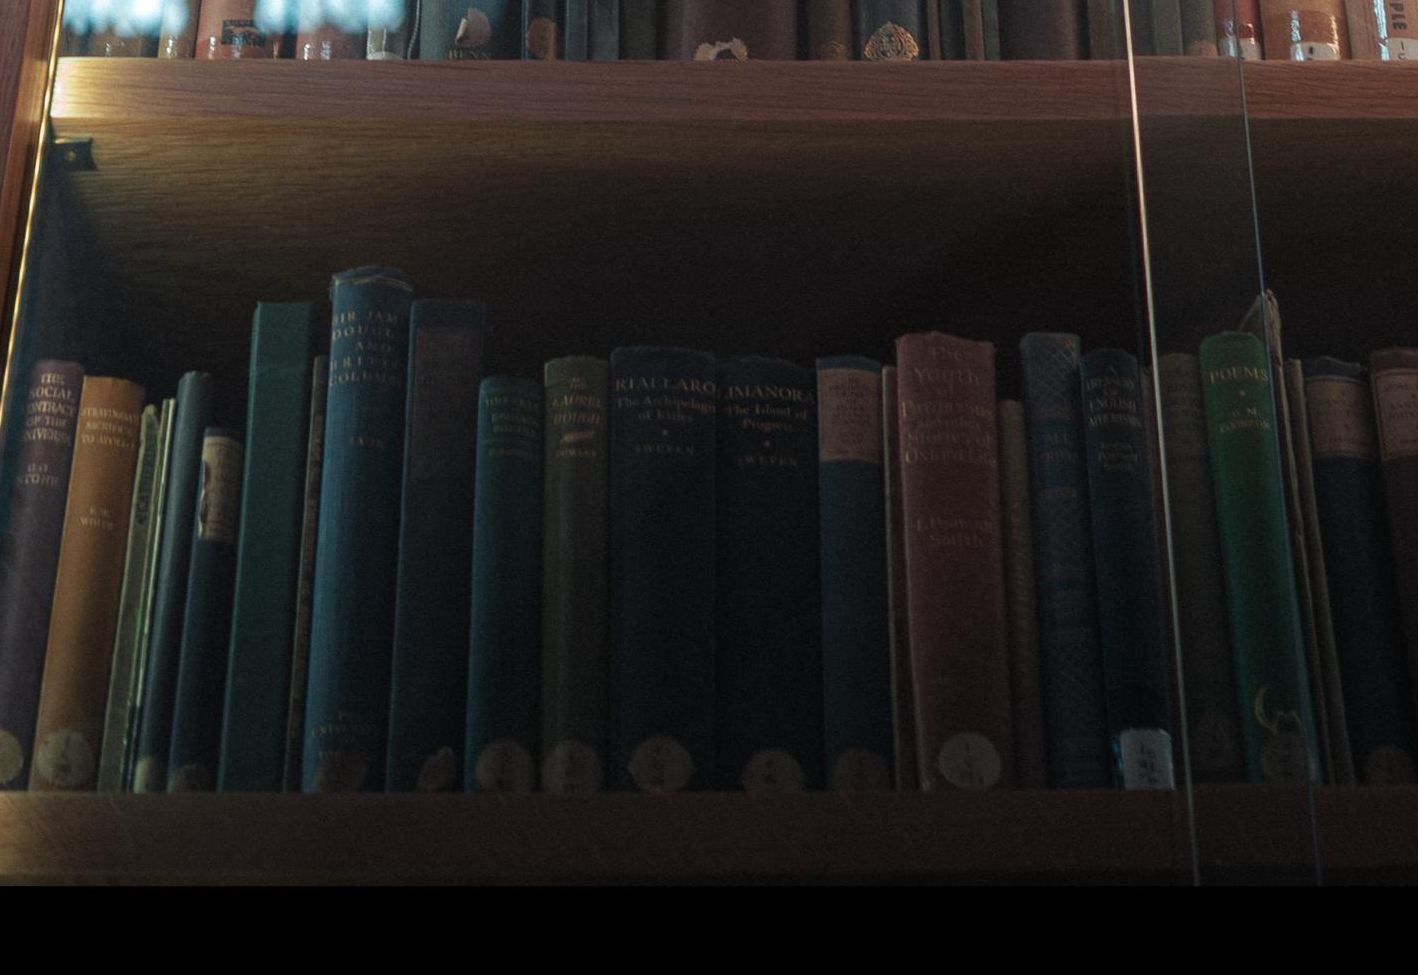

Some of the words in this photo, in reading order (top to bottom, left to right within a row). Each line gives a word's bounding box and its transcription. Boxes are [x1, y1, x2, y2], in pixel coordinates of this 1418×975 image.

[332, 311, 358, 325] SIR
[354, 340, 391, 353] AND
[40, 373, 65, 385] THE
[914, 366, 980, 385] Youth
[1209, 367, 1269, 385] POEMS
[30, 388, 73, 401] SOCIAL
[617, 397, 637, 409] The
[638, 411, 649, 420] of
[726, 404, 750, 416] The
[754, 403, 791, 417] Island
[795, 407, 808, 420] of
[44, 417, 68, 427] THE
